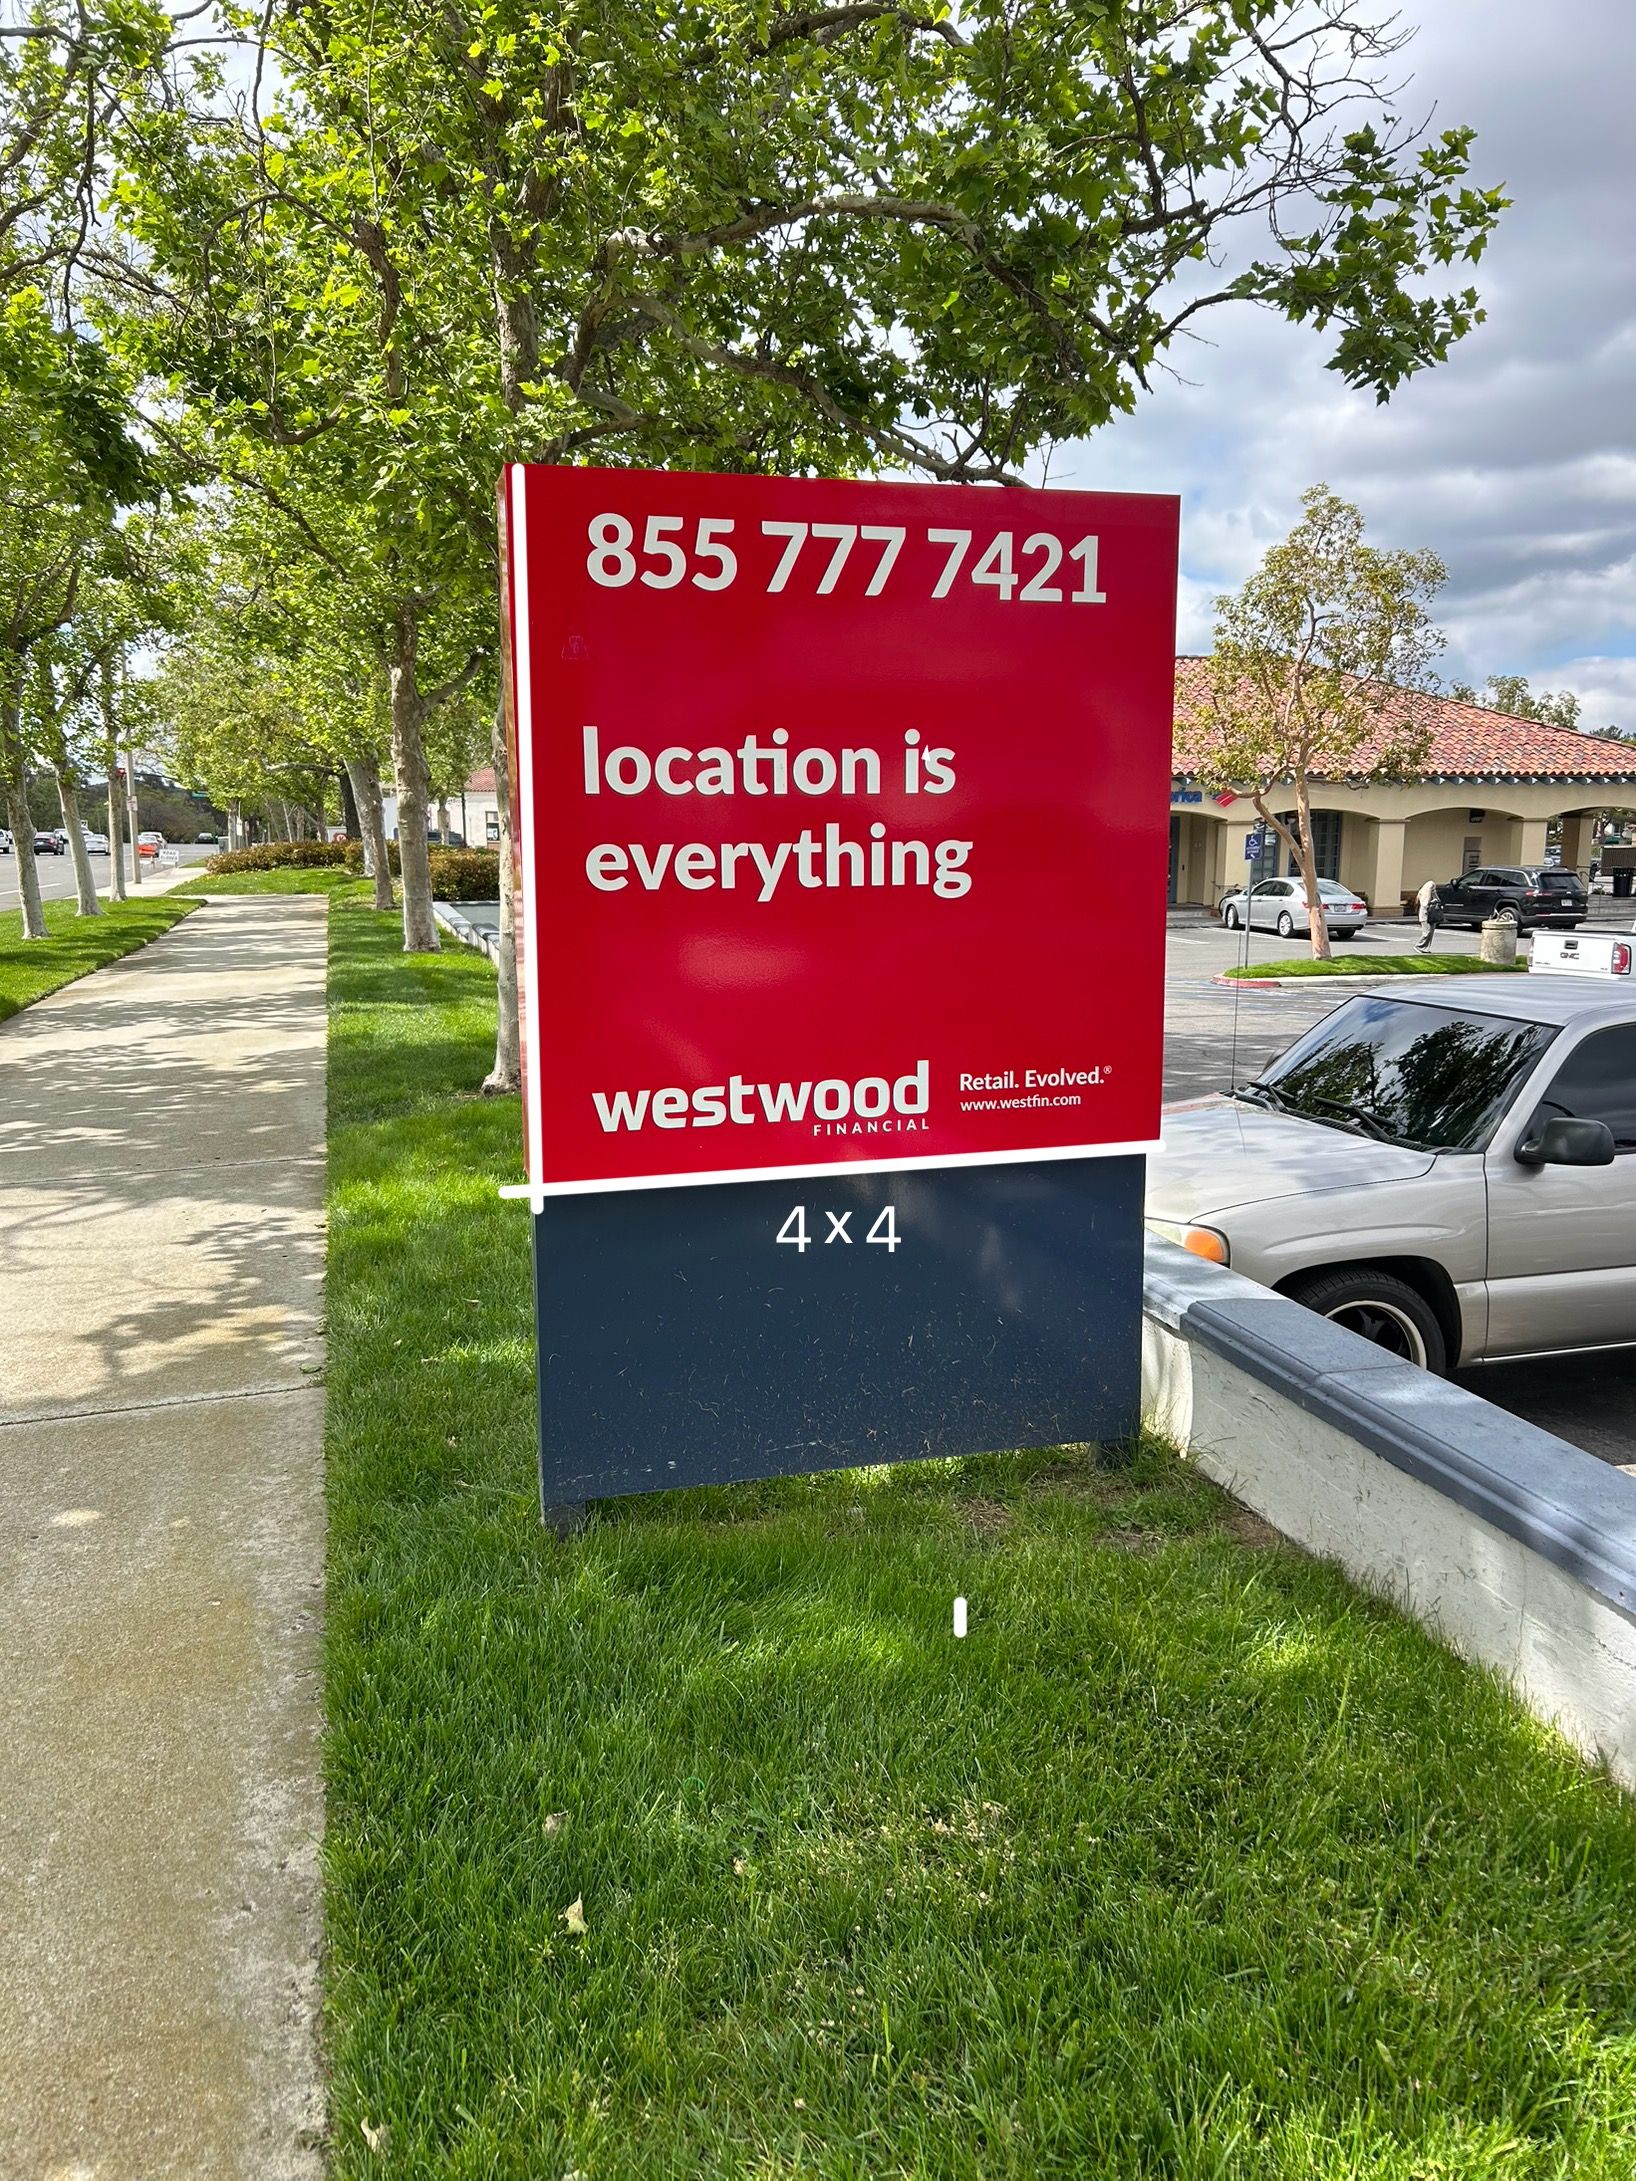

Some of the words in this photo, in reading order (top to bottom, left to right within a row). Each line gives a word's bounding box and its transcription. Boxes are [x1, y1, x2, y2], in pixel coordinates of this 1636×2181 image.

[586, 512, 738, 592] 855
[761, 520, 907, 597] 777
[927, 527, 1107, 604] 7421
[582, 725, 881, 796] location
[904, 728, 957, 795] is
[585, 822, 974, 903] everything
[1560, 952, 1579, 960] GMC
[591, 1059, 930, 1133] westwood
[959, 1070, 1020, 1092] Retail.
[959, 1093, 1082, 1112] www.westfin.com
[812, 1118, 931, 1137] FINANCIAL
